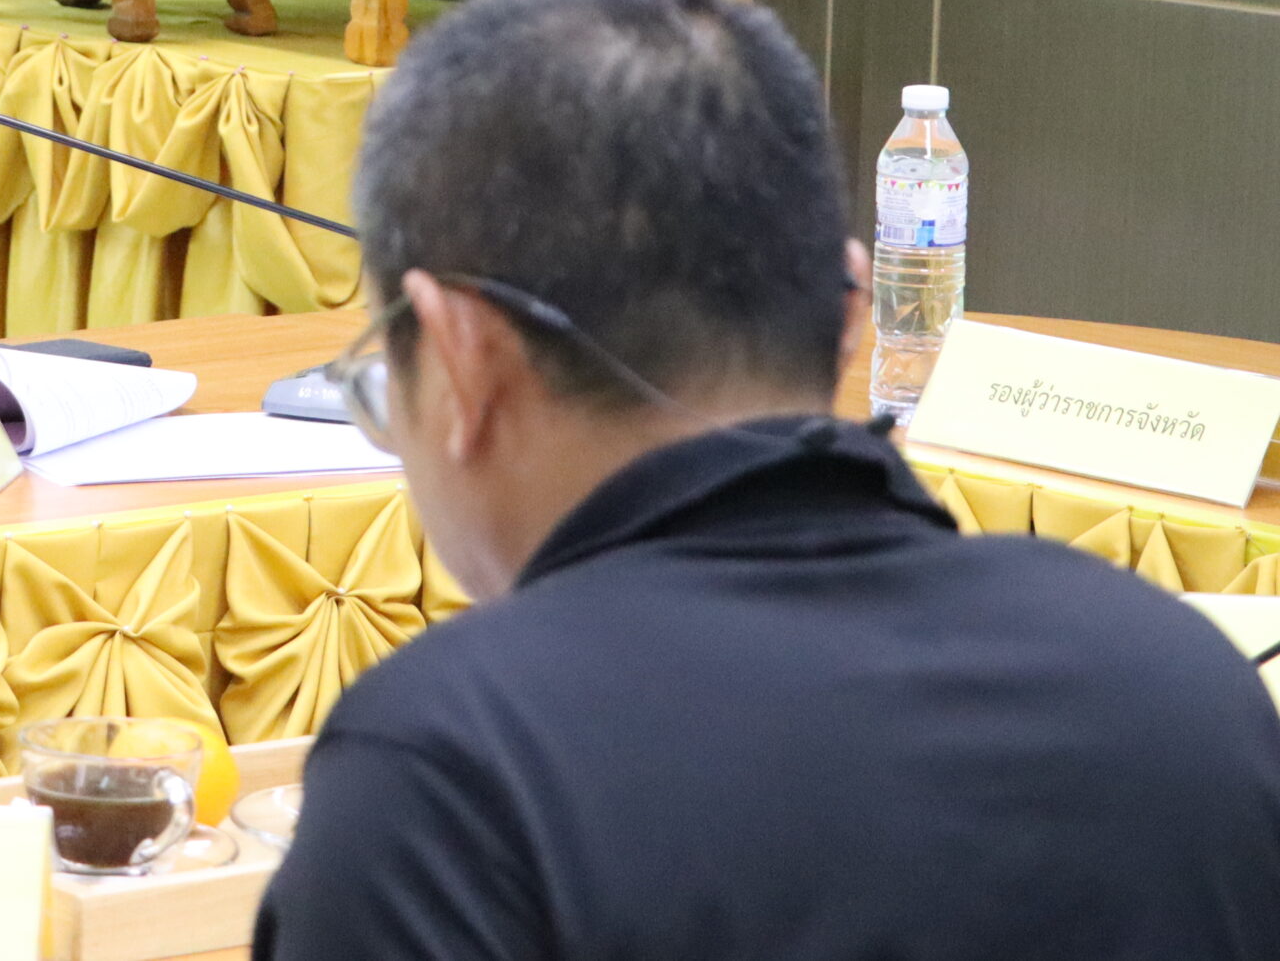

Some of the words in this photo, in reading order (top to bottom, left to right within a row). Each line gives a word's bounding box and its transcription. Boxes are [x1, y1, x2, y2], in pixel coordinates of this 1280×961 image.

[988, 379, 1207, 442] รองผู้ว่าราชการจังหวัด
